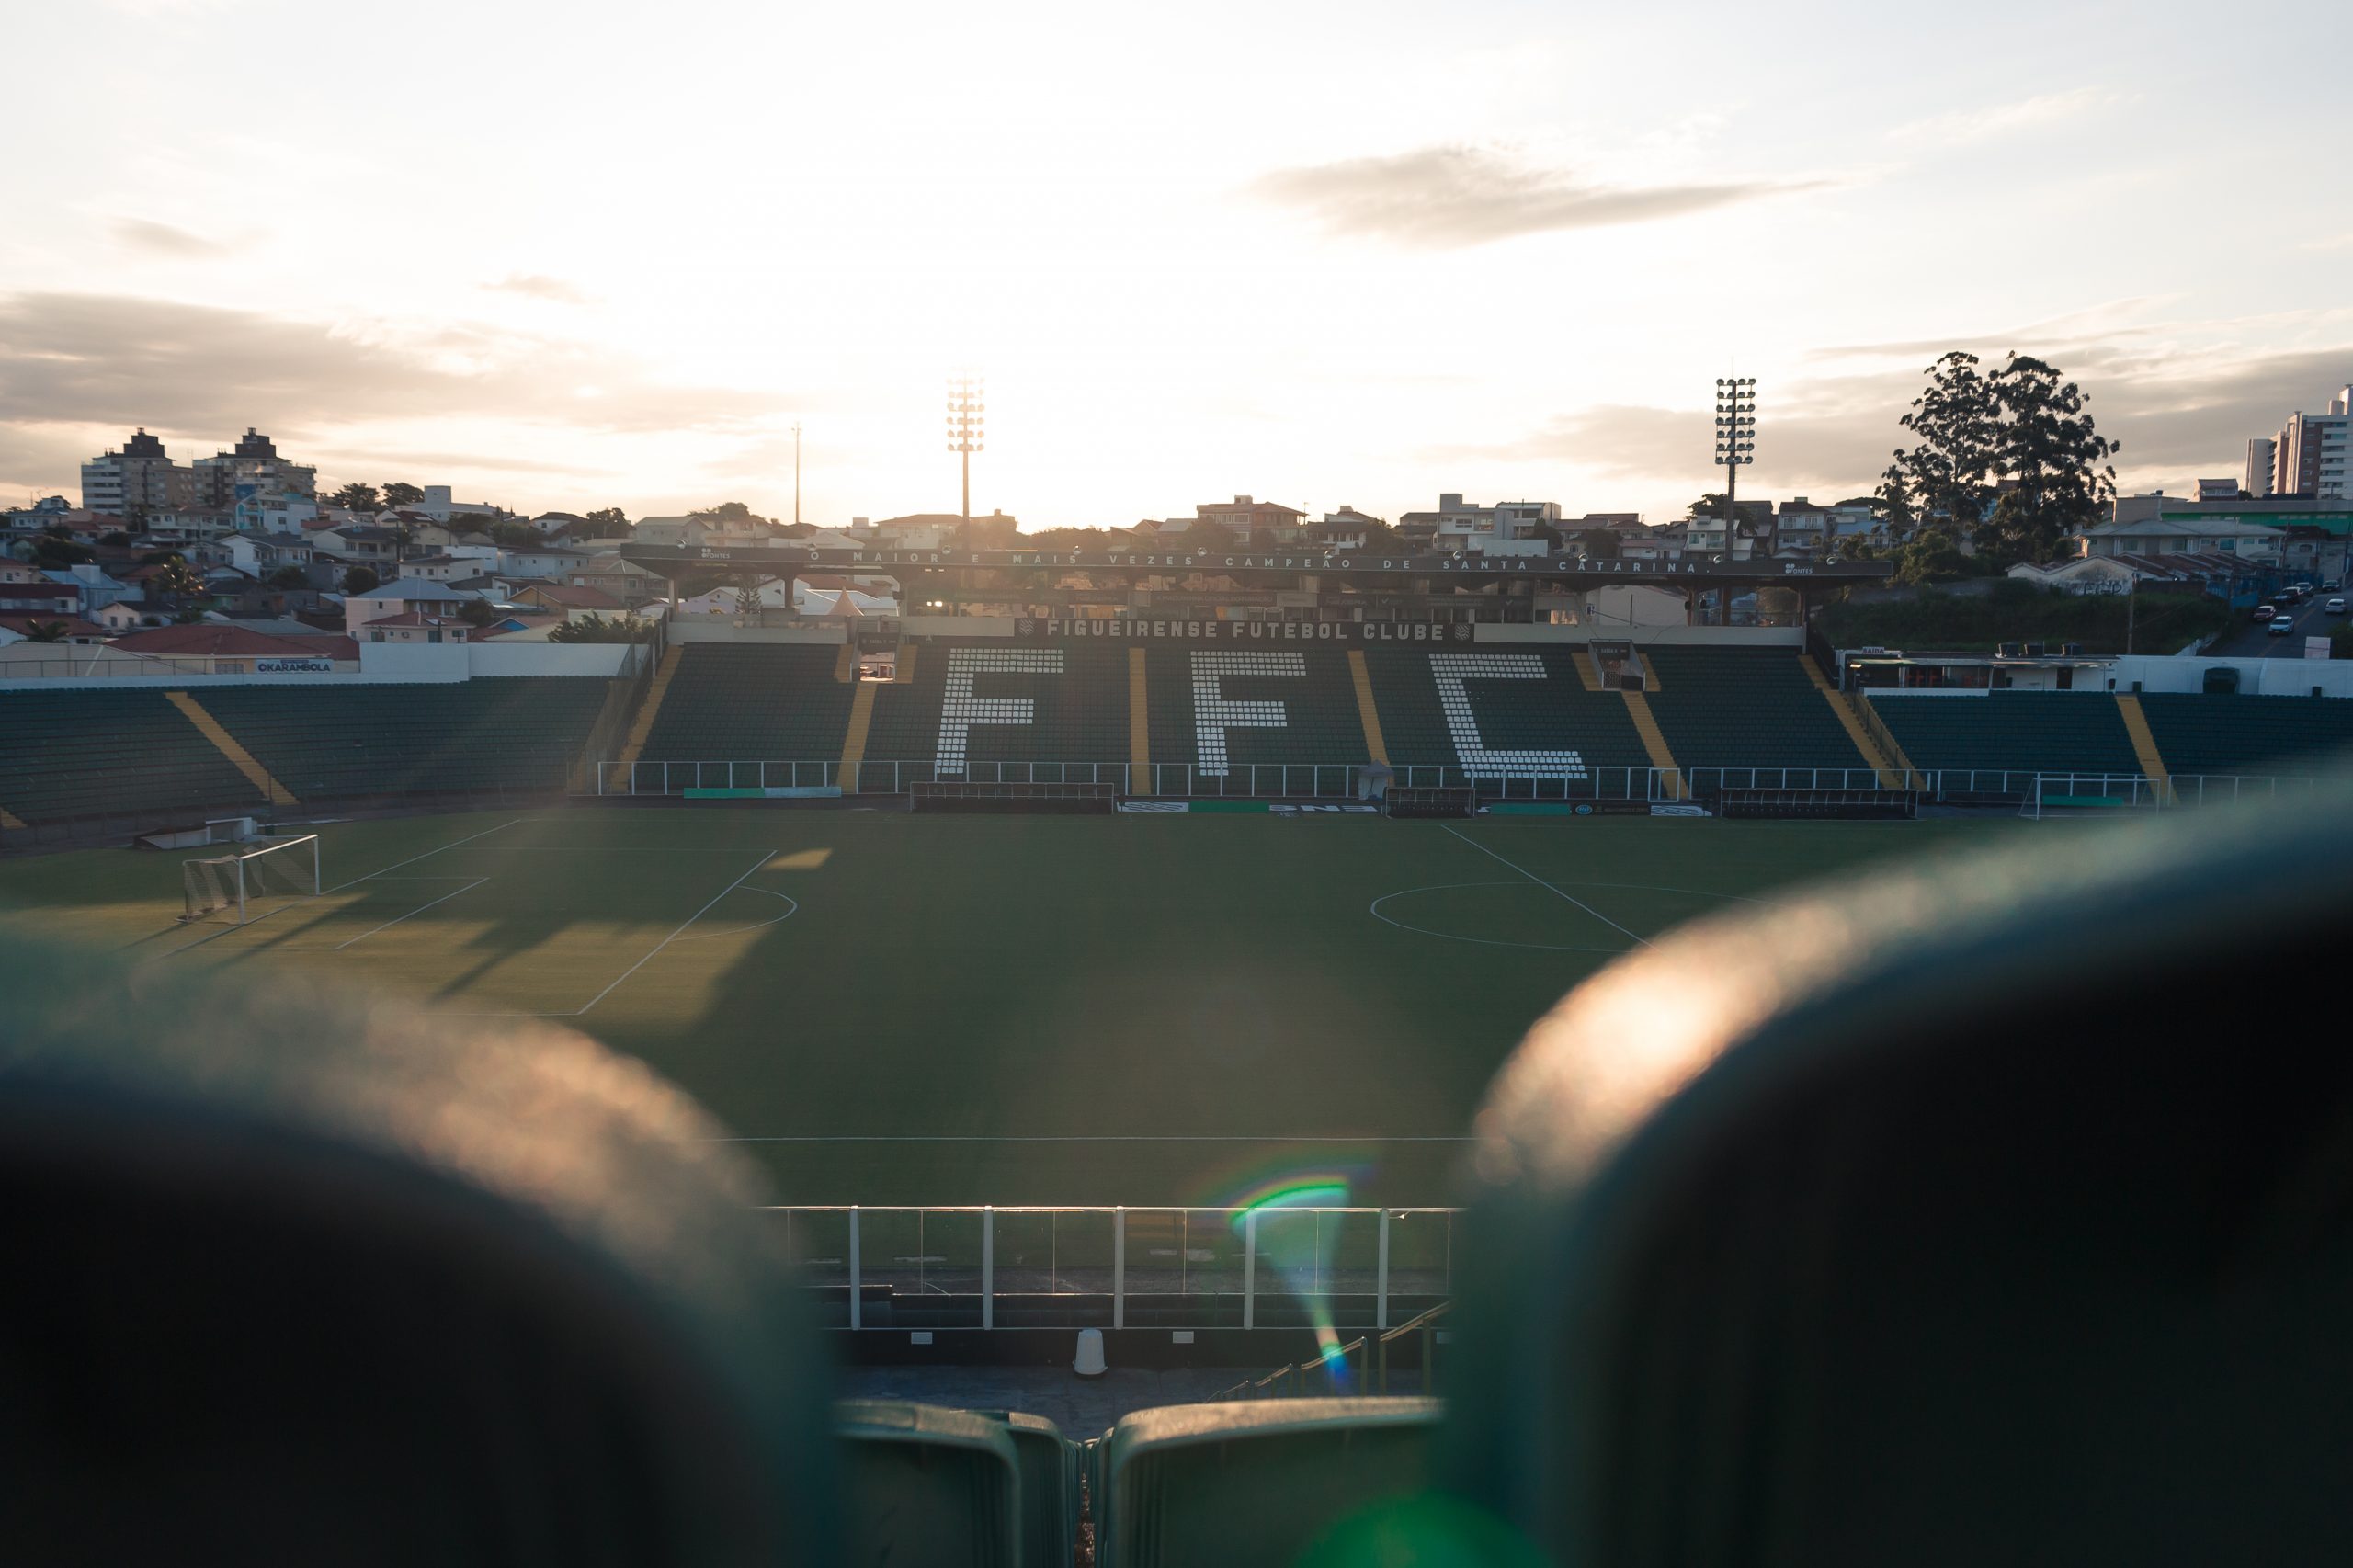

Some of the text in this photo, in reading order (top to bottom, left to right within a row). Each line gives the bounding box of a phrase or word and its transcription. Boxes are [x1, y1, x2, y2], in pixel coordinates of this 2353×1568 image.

[811, 552, 820, 561] O
[853, 552, 938, 562] MAIOR
[972, 554, 979, 563] E
[1013, 554, 1076, 564] MAIS
[1109, 555, 1192, 565] VEZES
[1383, 560, 1409, 569] DE
[1443, 561, 1526, 571] SANTA
[1047, 619, 1444, 640] FIGUEIRENSE FUTEBOL CLUBE
